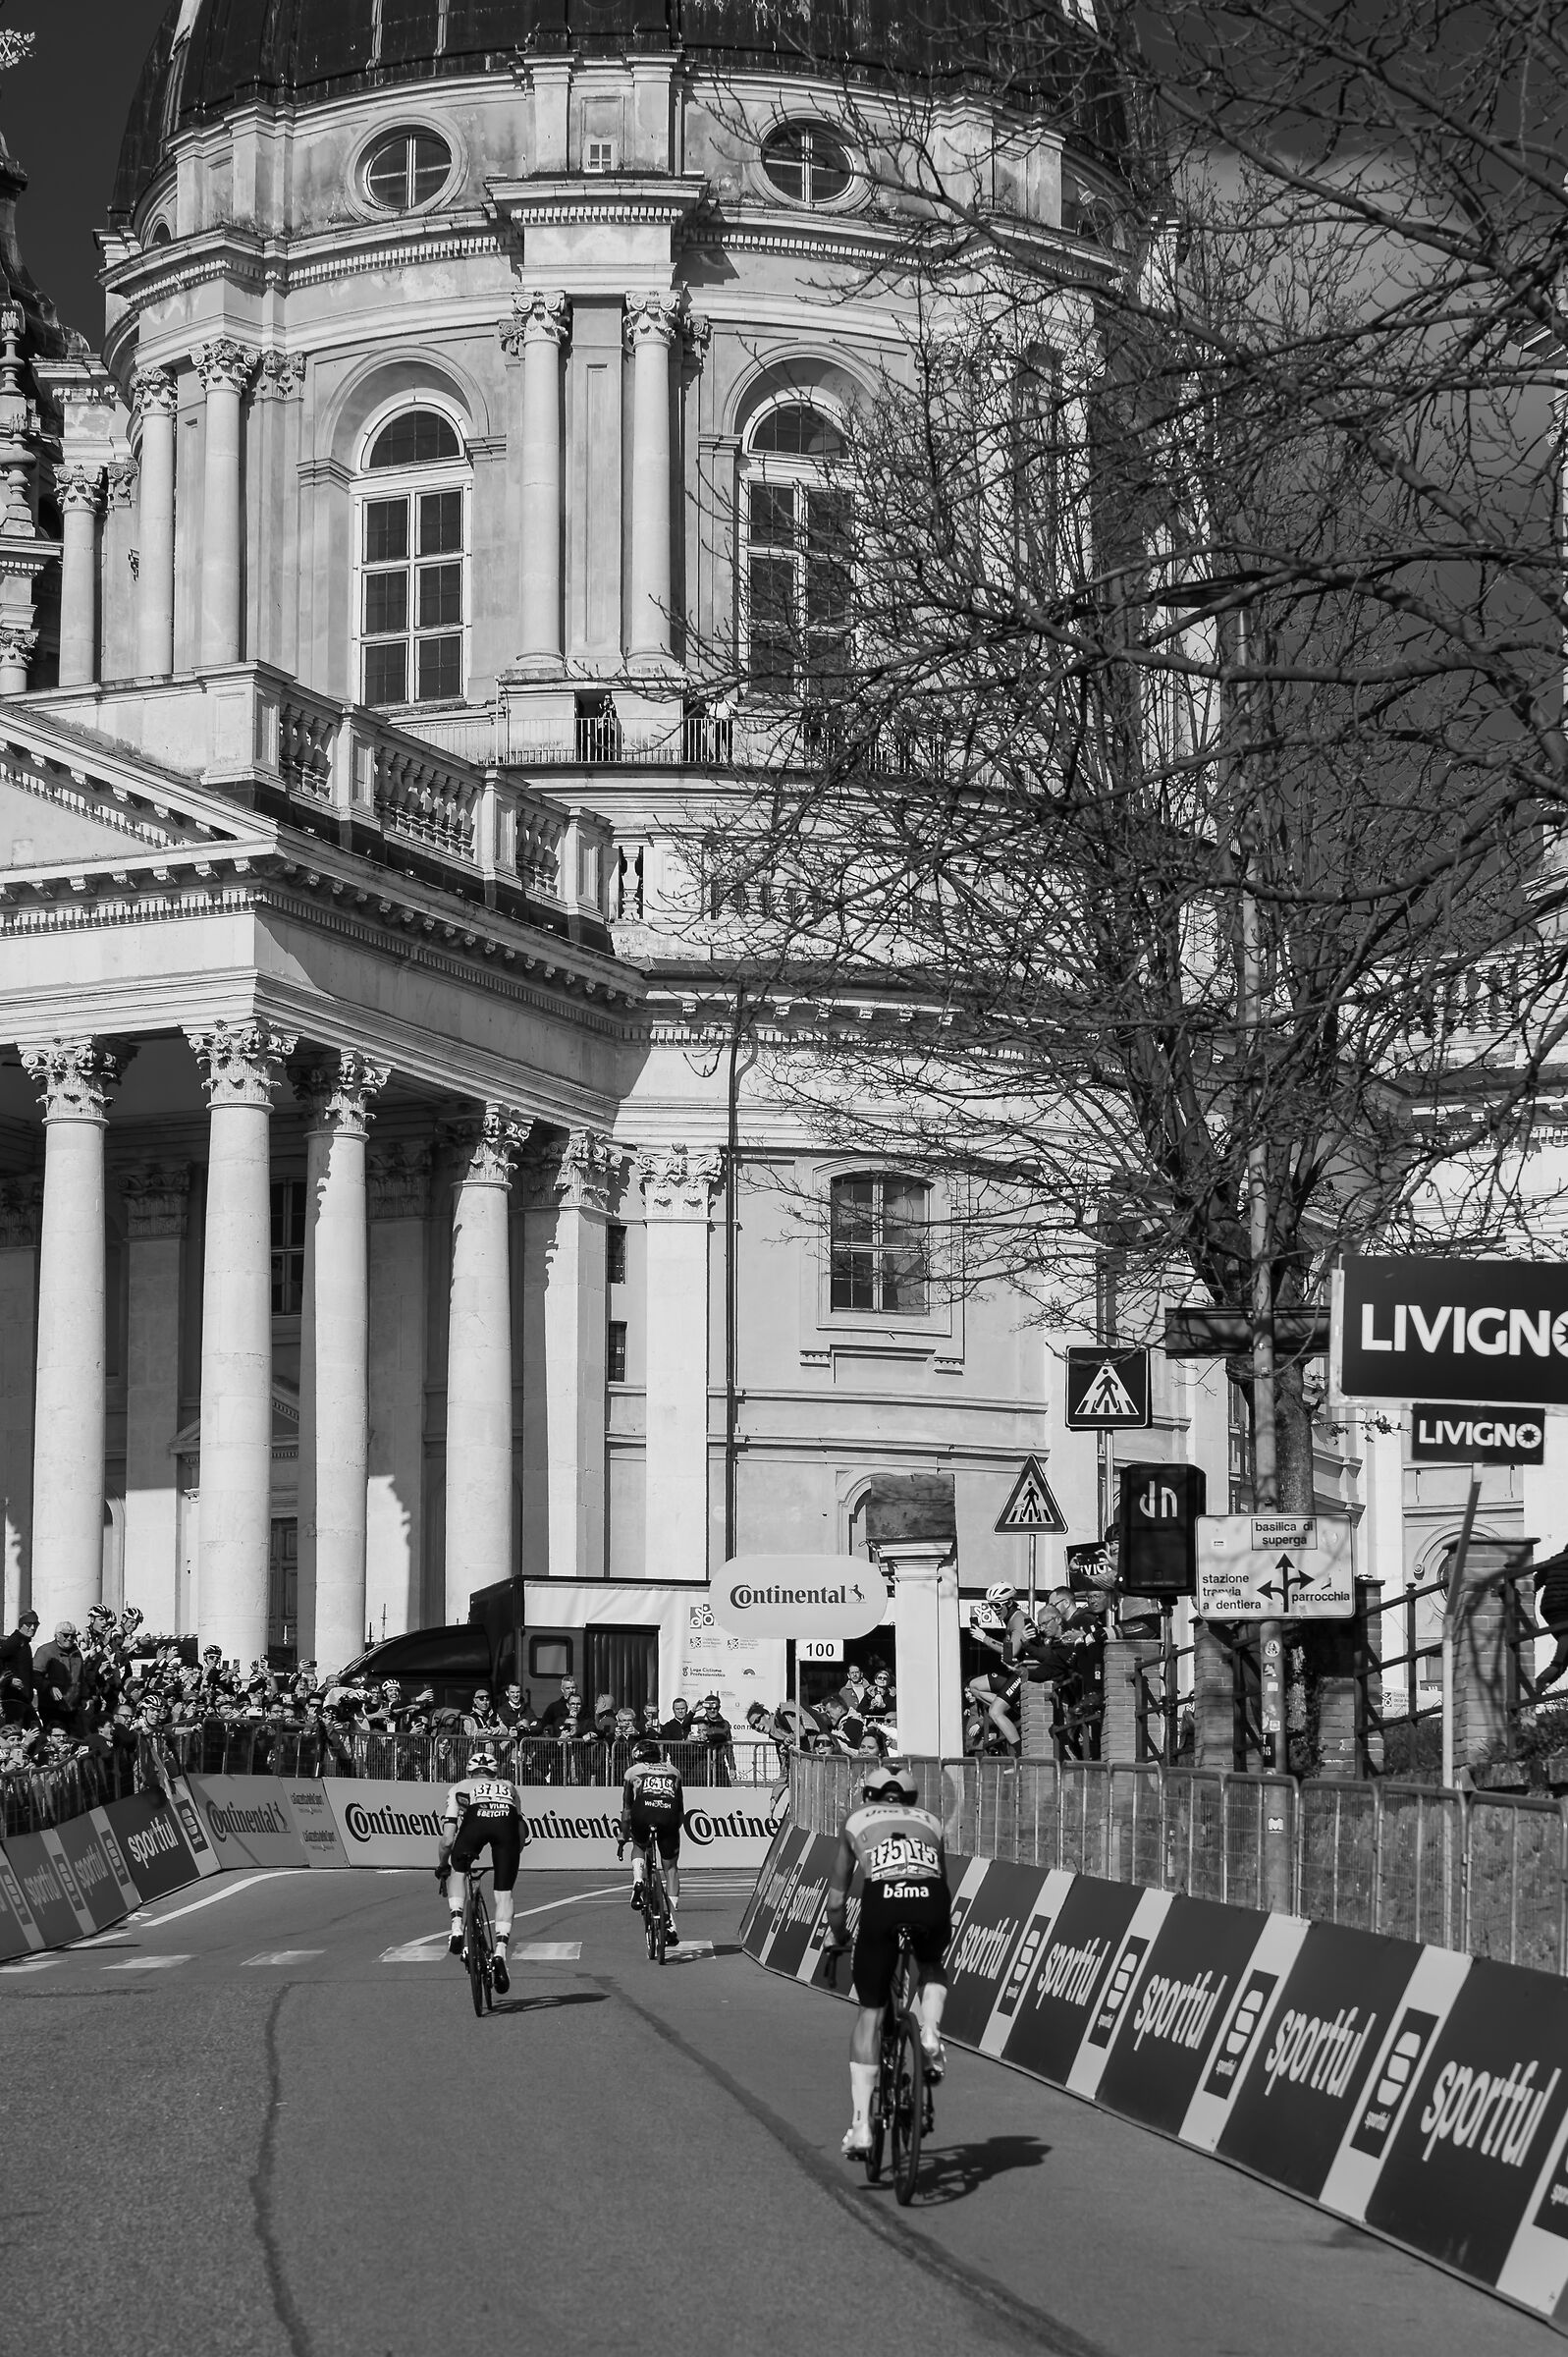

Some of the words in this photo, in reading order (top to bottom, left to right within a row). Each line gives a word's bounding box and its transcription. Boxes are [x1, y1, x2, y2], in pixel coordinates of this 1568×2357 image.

[1419, 1420, 1541, 1449] LIVIGNO
[1255, 1521, 1297, 1532] basilica
[1303, 1521, 1314, 1531] di
[1262, 1535, 1308, 1547] superga
[1202, 1573, 1250, 1584] stazione
[730, 1584, 846, 1609] Continental
[1216, 1600, 1262, 1610] dentiera
[1291, 1591, 1350, 1604] parrocchia
[806, 1643, 835, 1657] 100
[205, 1800, 280, 1842] Continental
[345, 1803, 446, 1842] Continent
[683, 1808, 783, 1845] Contine
[128, 1814, 179, 1869] sportful
[872, 1839, 902, 1868] 175
[952, 1917, 1019, 1985] sportful
[1035, 1937, 1111, 2010] sportful
[1133, 1970, 1227, 2052] sportful
[1264, 2005, 1377, 2097] sportful
[1421, 2060, 1562, 2168] sportful
